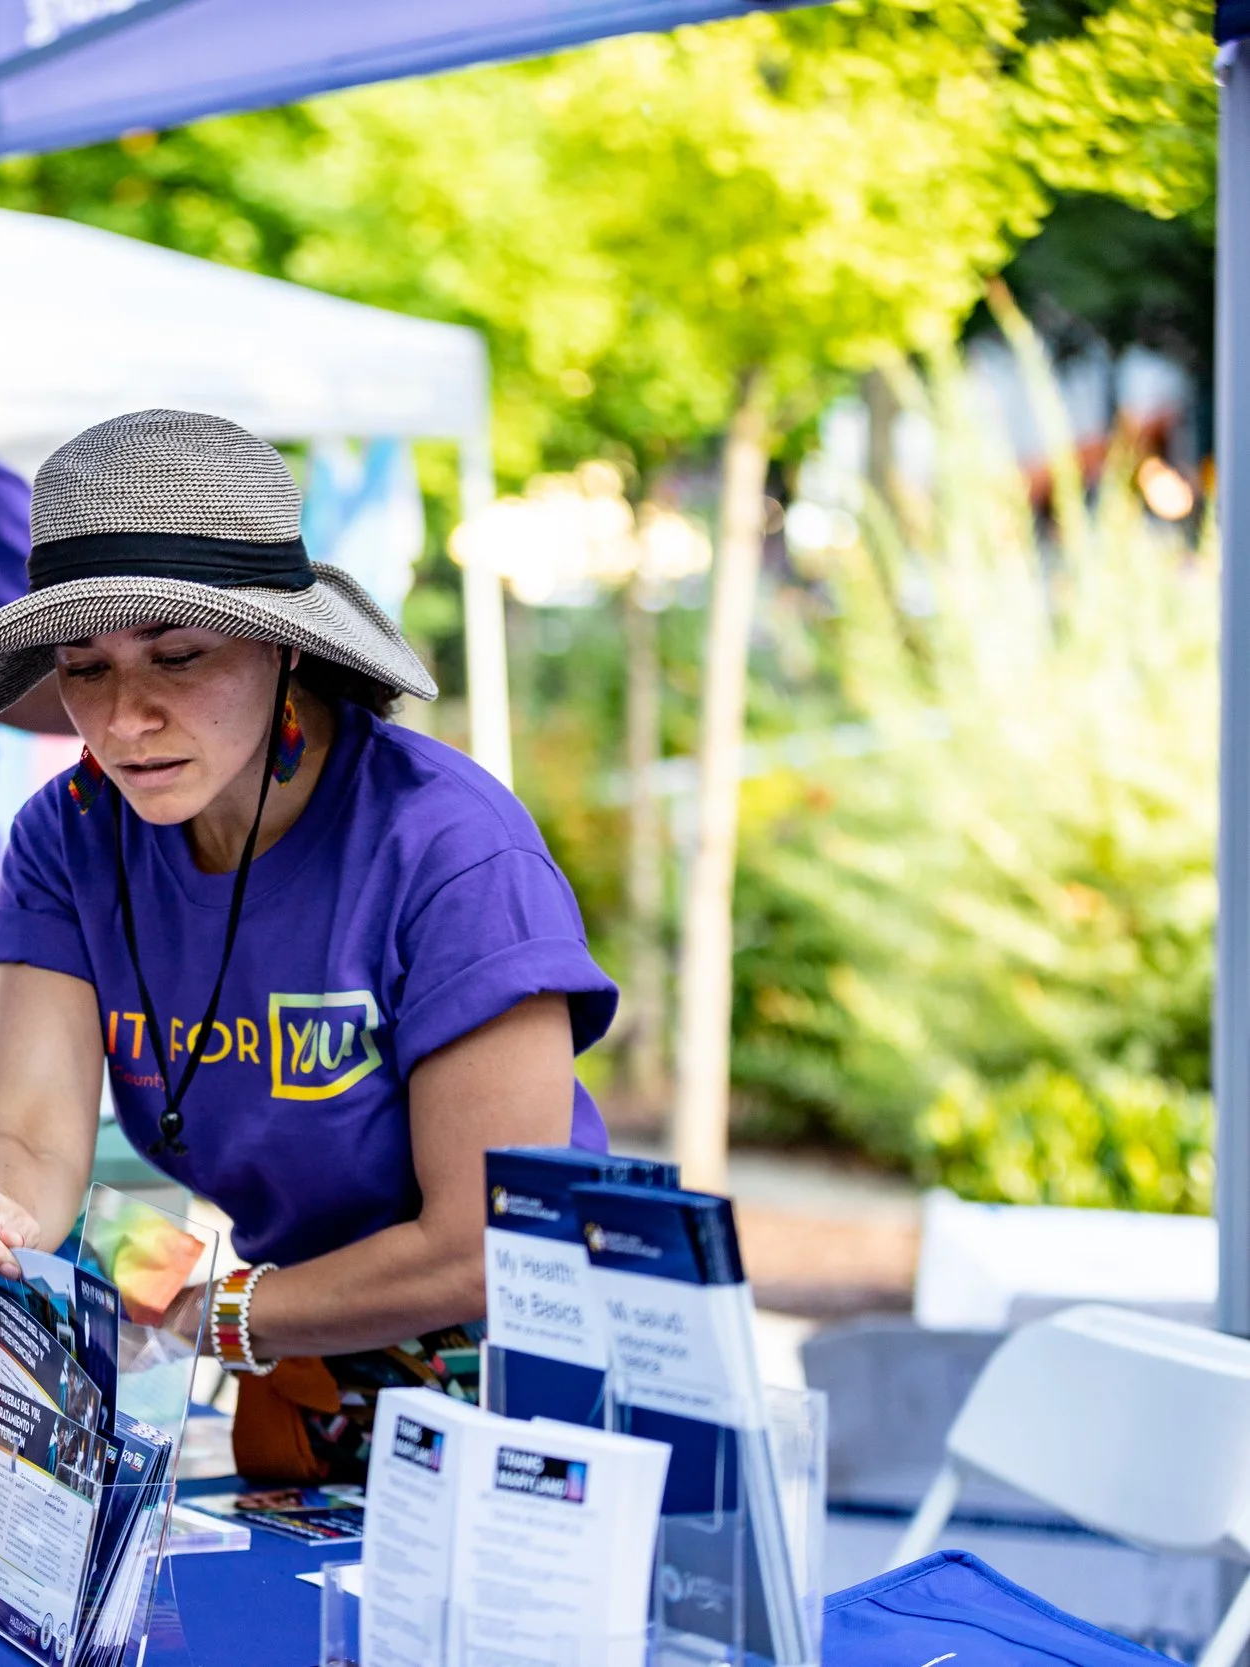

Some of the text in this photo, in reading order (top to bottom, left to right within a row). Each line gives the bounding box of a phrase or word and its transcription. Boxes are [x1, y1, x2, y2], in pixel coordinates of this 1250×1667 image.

[108, 1010, 354, 1075] IT FOR YOU
[20, 1400, 31, 1417] DEL
[30, 1423, 36, 1436] Y
[122, 1449, 134, 1464] FOR
